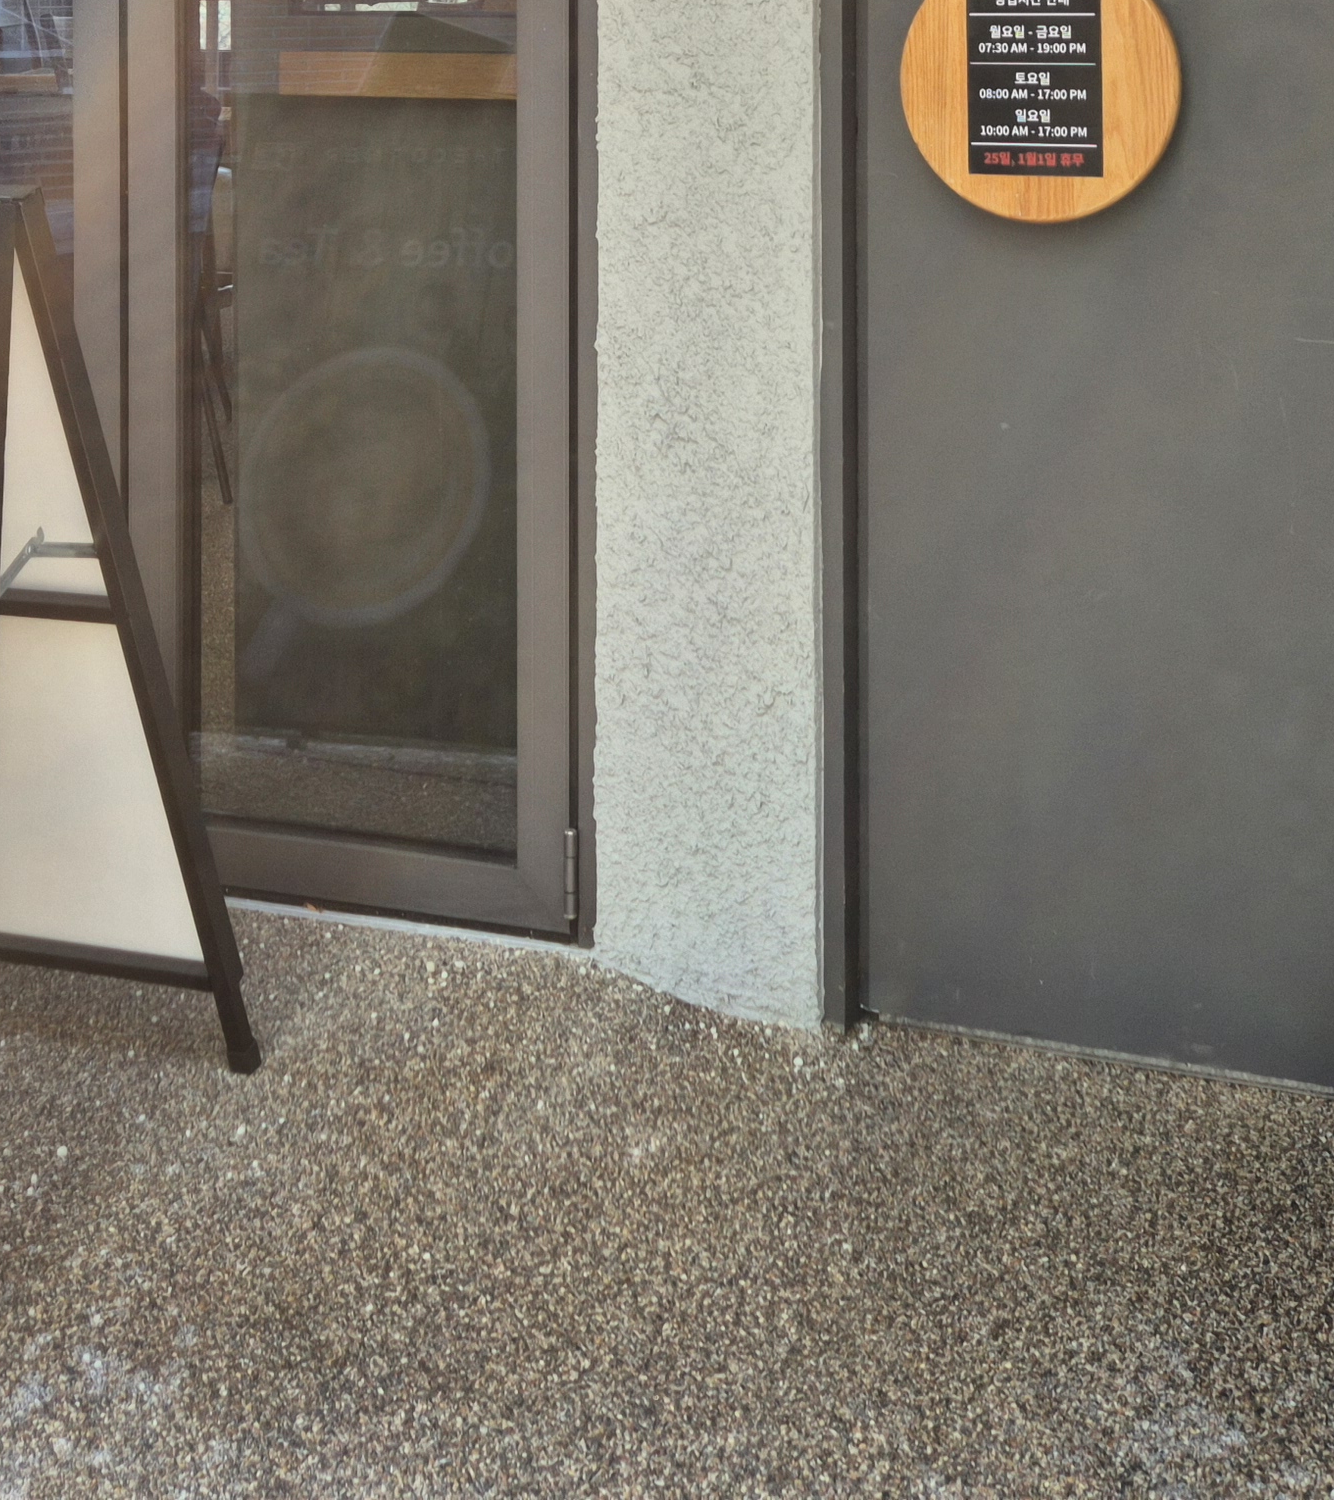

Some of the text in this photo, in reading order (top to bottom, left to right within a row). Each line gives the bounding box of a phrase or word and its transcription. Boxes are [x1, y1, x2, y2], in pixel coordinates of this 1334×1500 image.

[989, 25, 1025, 38] 월요일
[1035, 25, 1071, 38] 금요일
[979, 43, 1008, 53] 07:30
[1011, 43, 1027, 53] AM
[1037, 43, 1069, 53] 19:00
[1071, 43, 1086, 53] PM
[1015, 72, 1050, 85] 토요일
[979, 89, 1009, 99] 08:00
[1011, 89, 1028, 99] AM
[1038, 89, 1068, 100] 17:00
[1070, 90, 1087, 100] PM
[1015, 109, 1050, 122] 일요일
[980, 126, 1009, 137] 10:00
[1012, 126, 1028, 137] AM
[1038, 126, 1069, 137] 17:00
[1071, 127, 1087, 137] PM
[1061, 153, 1084, 167] 휴무
